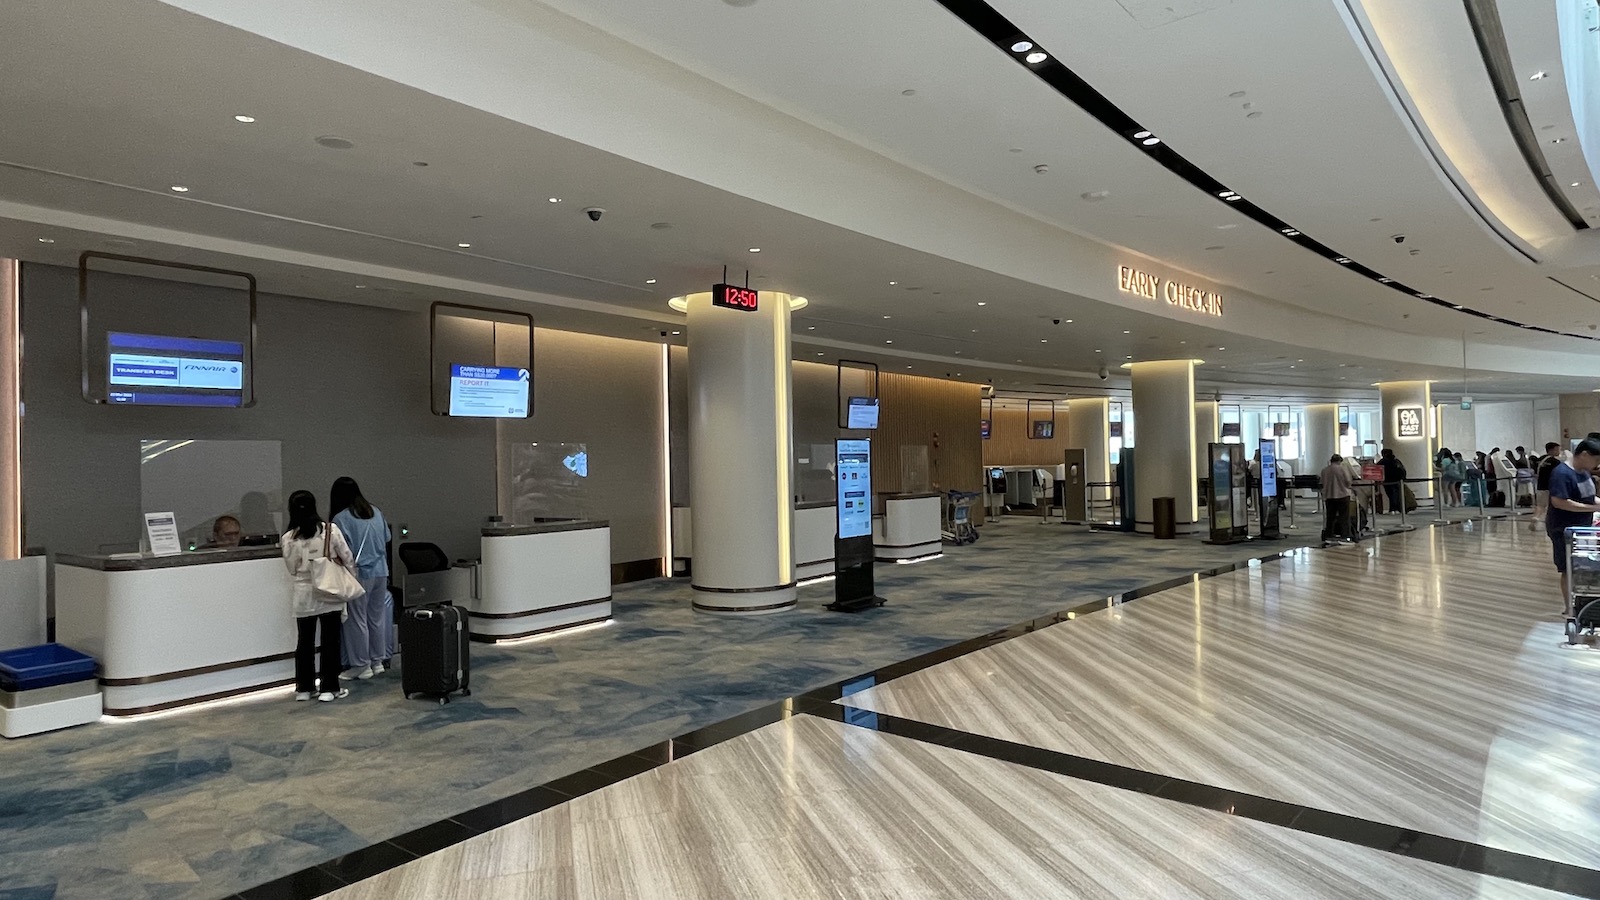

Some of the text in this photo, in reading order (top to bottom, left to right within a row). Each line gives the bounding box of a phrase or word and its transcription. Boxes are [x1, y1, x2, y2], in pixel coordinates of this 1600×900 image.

[726, 288, 756, 307] 12:50
[1118, 265, 1223, 317] EARLY CHECK-IN
